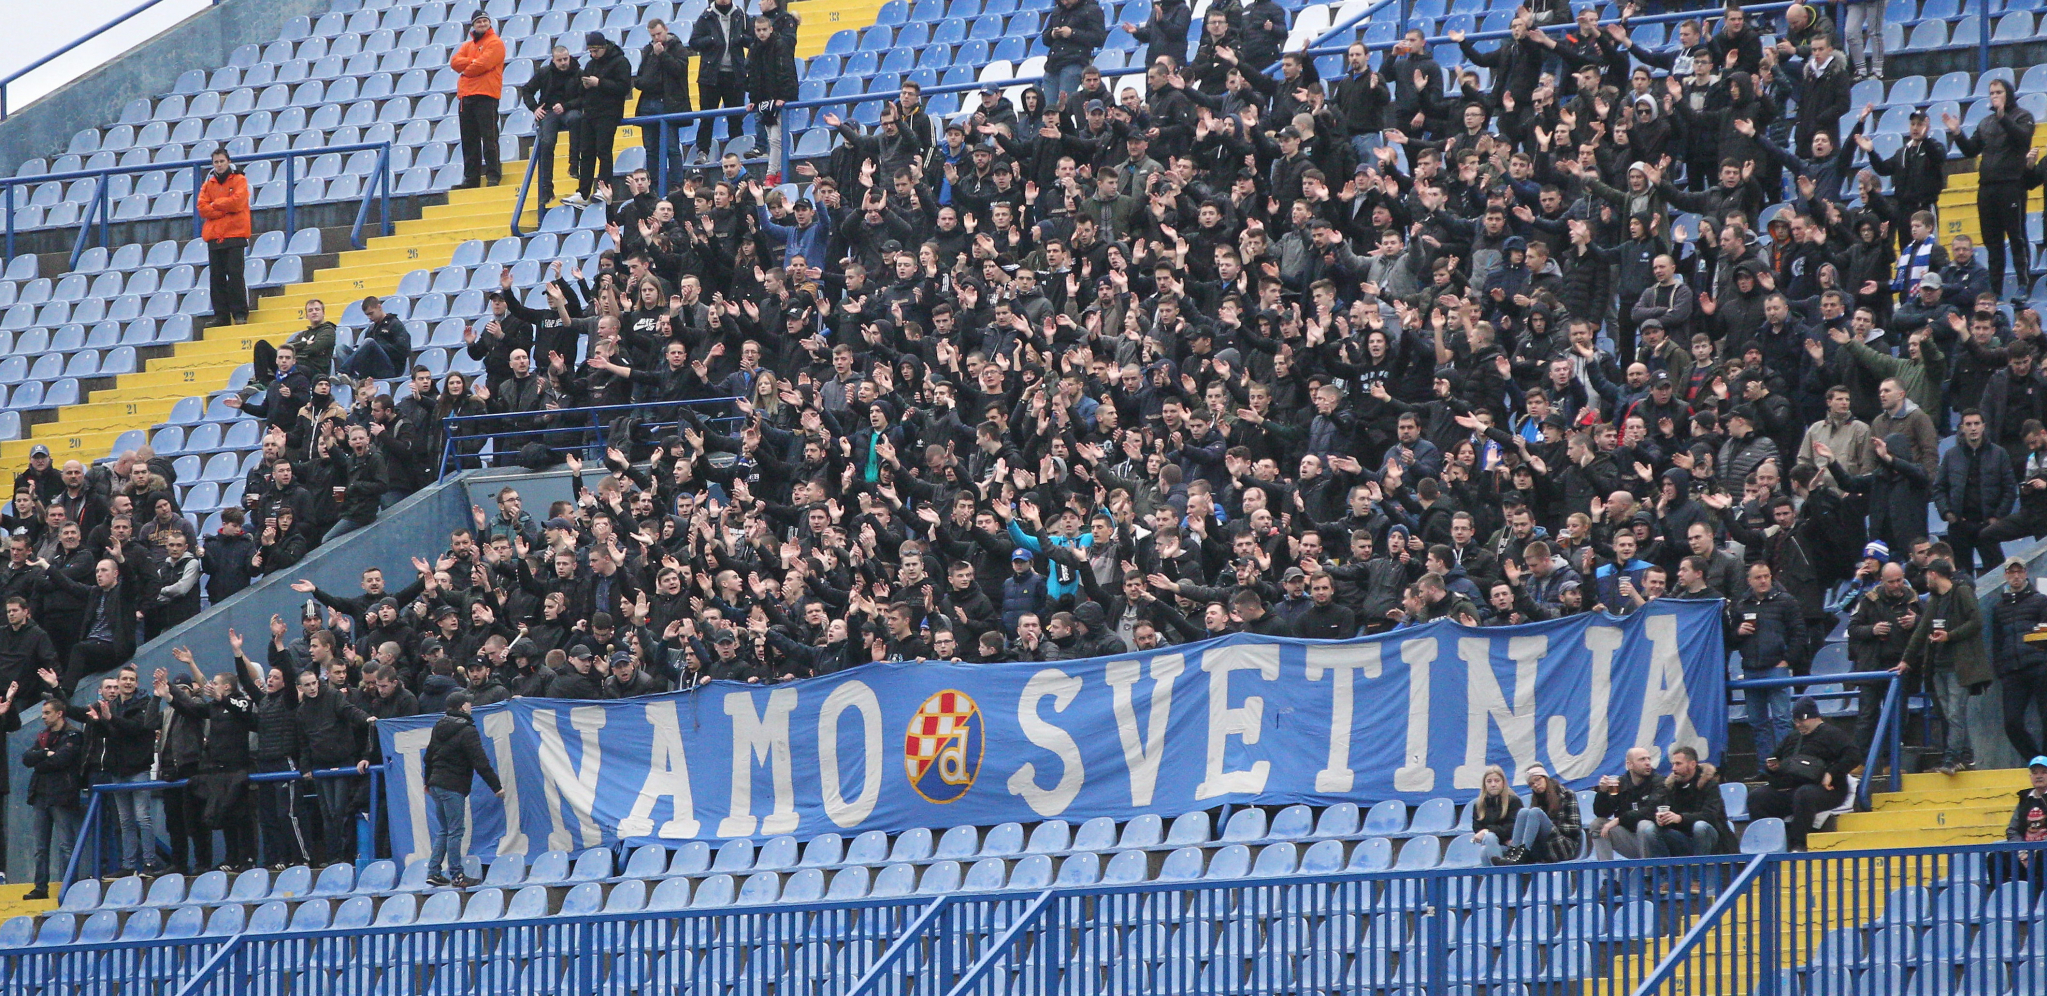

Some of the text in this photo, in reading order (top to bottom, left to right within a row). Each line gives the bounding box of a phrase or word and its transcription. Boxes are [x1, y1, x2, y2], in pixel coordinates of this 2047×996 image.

[622, 128, 633, 138] 29
[1948, 221, 1962, 233] 22
[407, 248, 419, 259] 26
[353, 280, 364, 289] 25
[241, 339, 252, 350] 23
[183, 371, 195, 382] 22
[126, 404, 137, 414] 21
[69, 438, 81, 448] 20
[1006, 614, 1709, 817] SVETINJA
[1937, 812, 1945, 825] 6
[1675, 979, 1684, 992] 2
